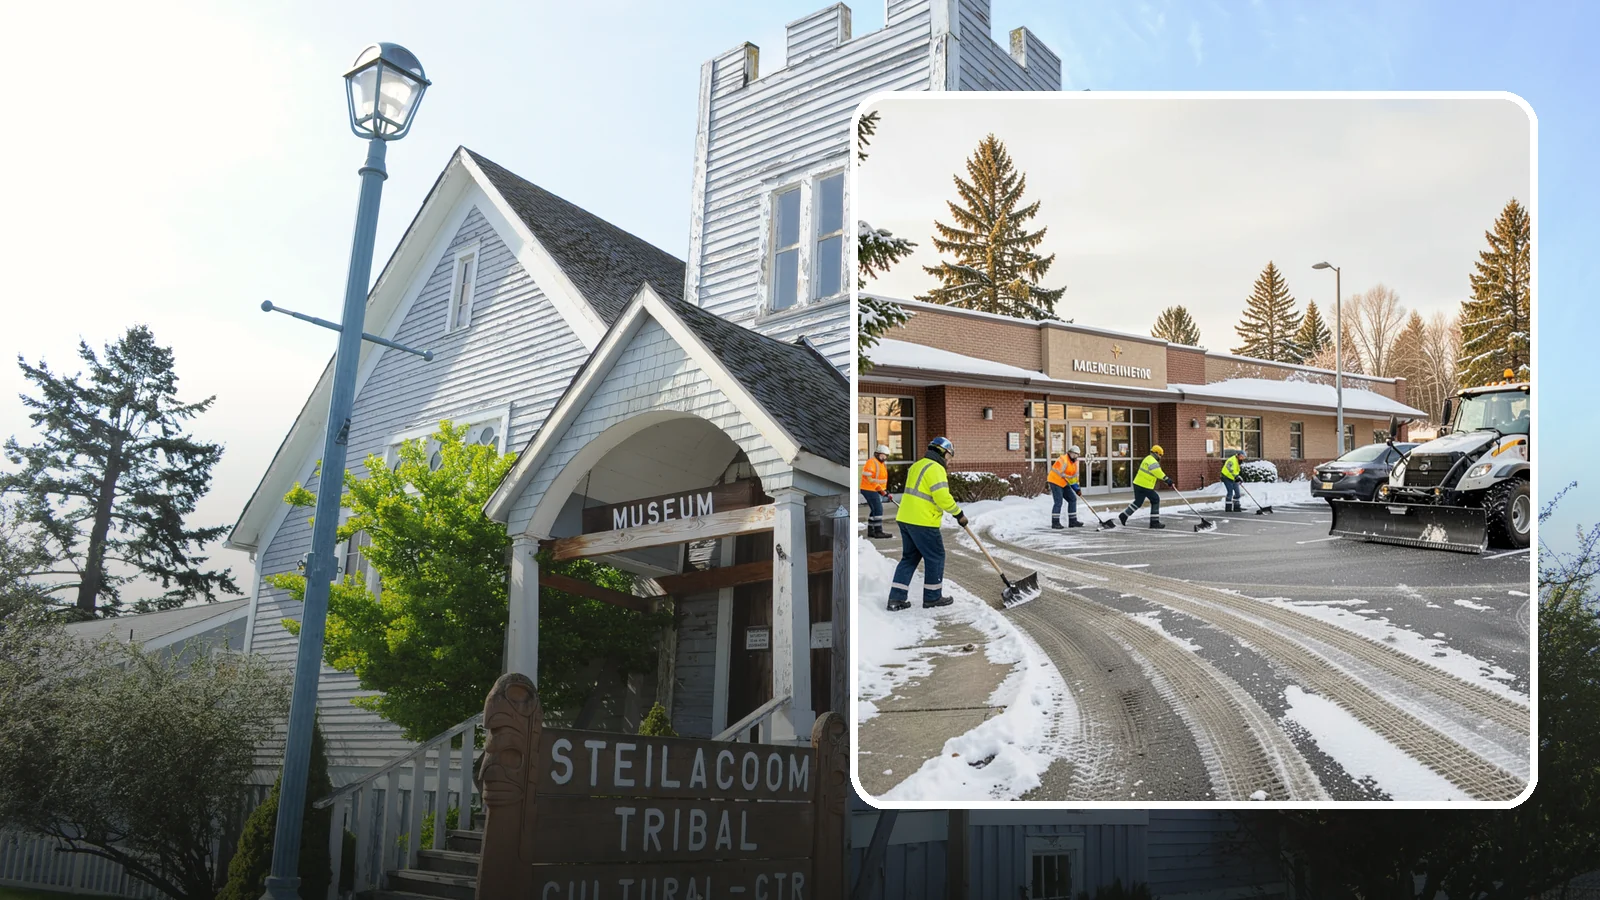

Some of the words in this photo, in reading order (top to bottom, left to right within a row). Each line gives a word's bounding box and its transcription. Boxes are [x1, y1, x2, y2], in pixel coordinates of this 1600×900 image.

[613, 491, 713, 531] MUSEUM
[550, 738, 810, 793] STEILACOOM
[614, 806, 758, 852] TRIBAL
